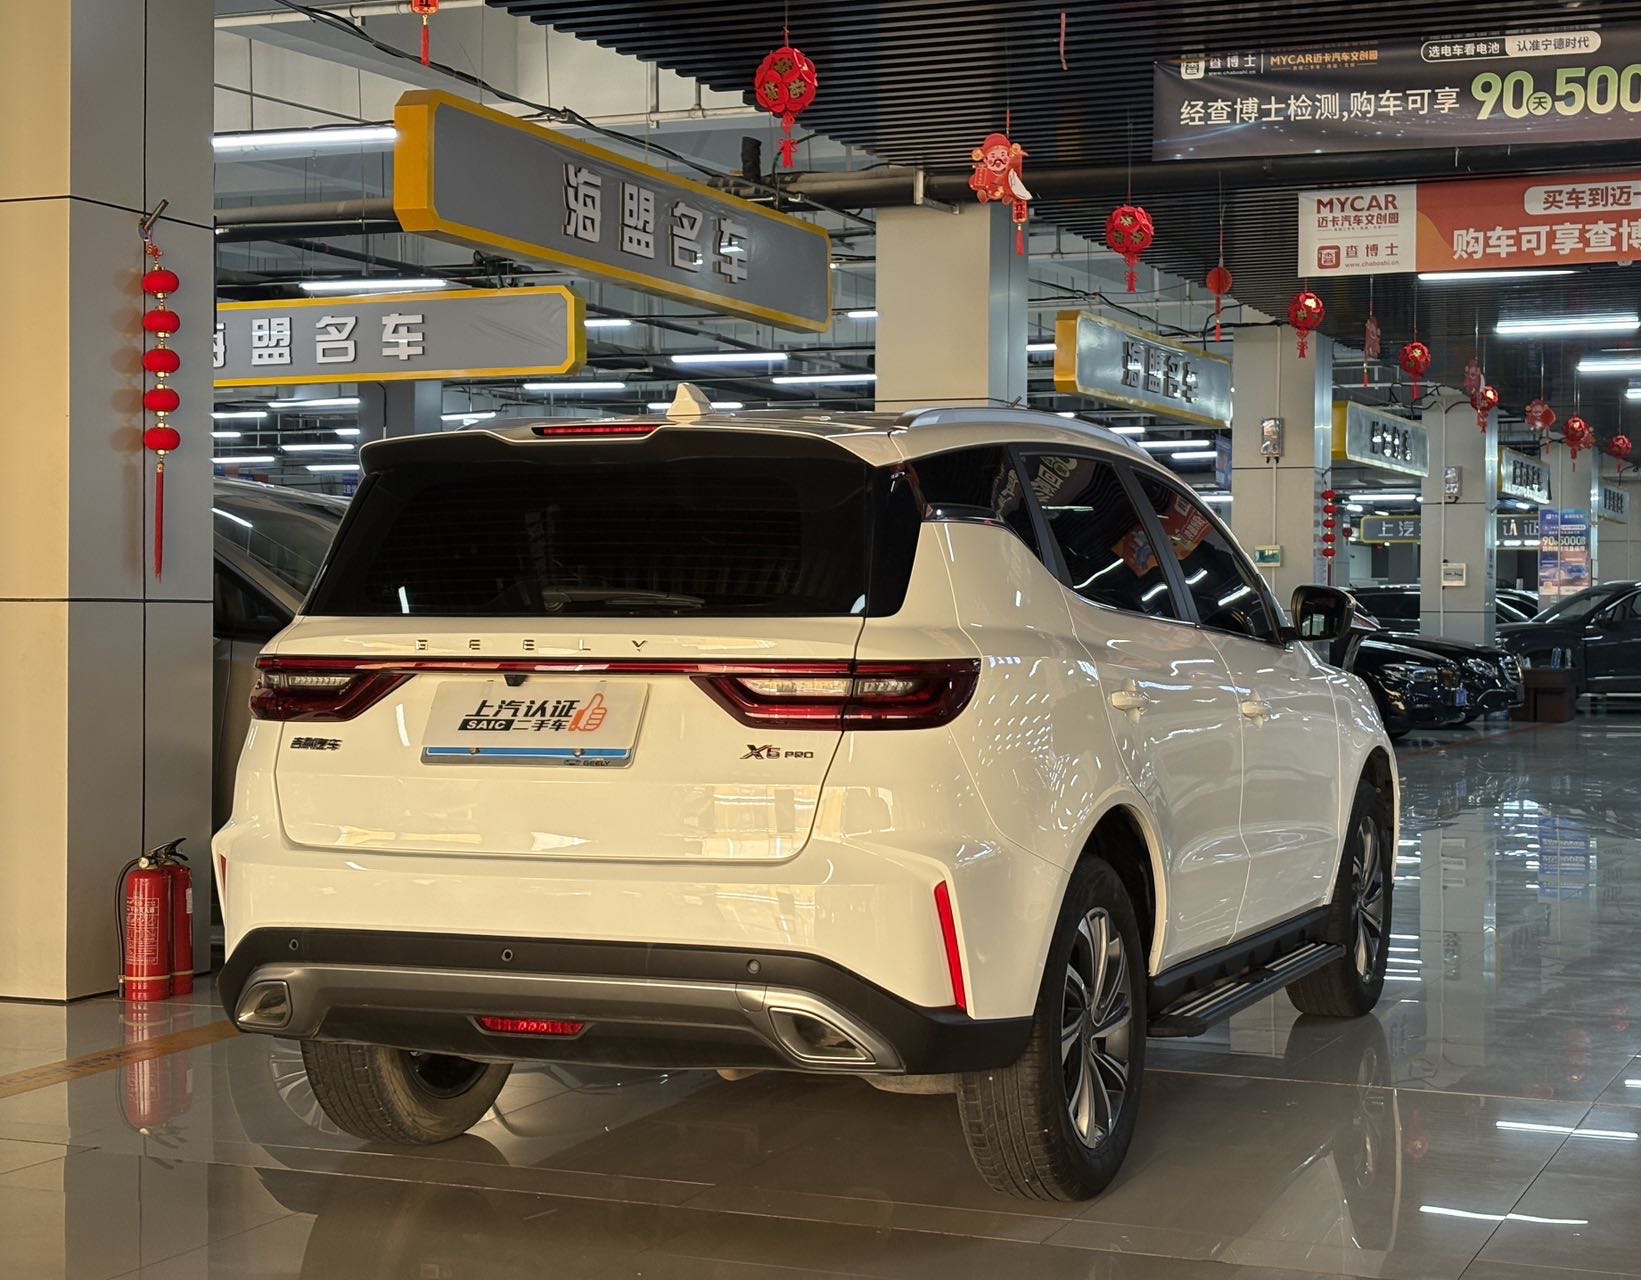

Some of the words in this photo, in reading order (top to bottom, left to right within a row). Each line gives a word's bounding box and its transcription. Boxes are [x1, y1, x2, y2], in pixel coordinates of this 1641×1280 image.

[1428, 42, 1500, 58] 选电车看电池
[1516, 36, 1590, 52] 认准宁德时代
[1316, 194, 1399, 214] MYCAR
[1543, 185, 1641, 211] 买车到迈
[562, 163, 749, 284] 海盟名车
[1345, 242, 1399, 259] 查博士
[1378, 520, 1420, 537] 上汽
[415, 639, 648, 652] GEELY
[465, 699, 580, 718] 上汽认证
[467, 720, 507, 730] SAIC
[512, 719, 570, 732] 二手车
[583, 759, 611, 767] GEELY
[784, 751, 814, 759] PRO
